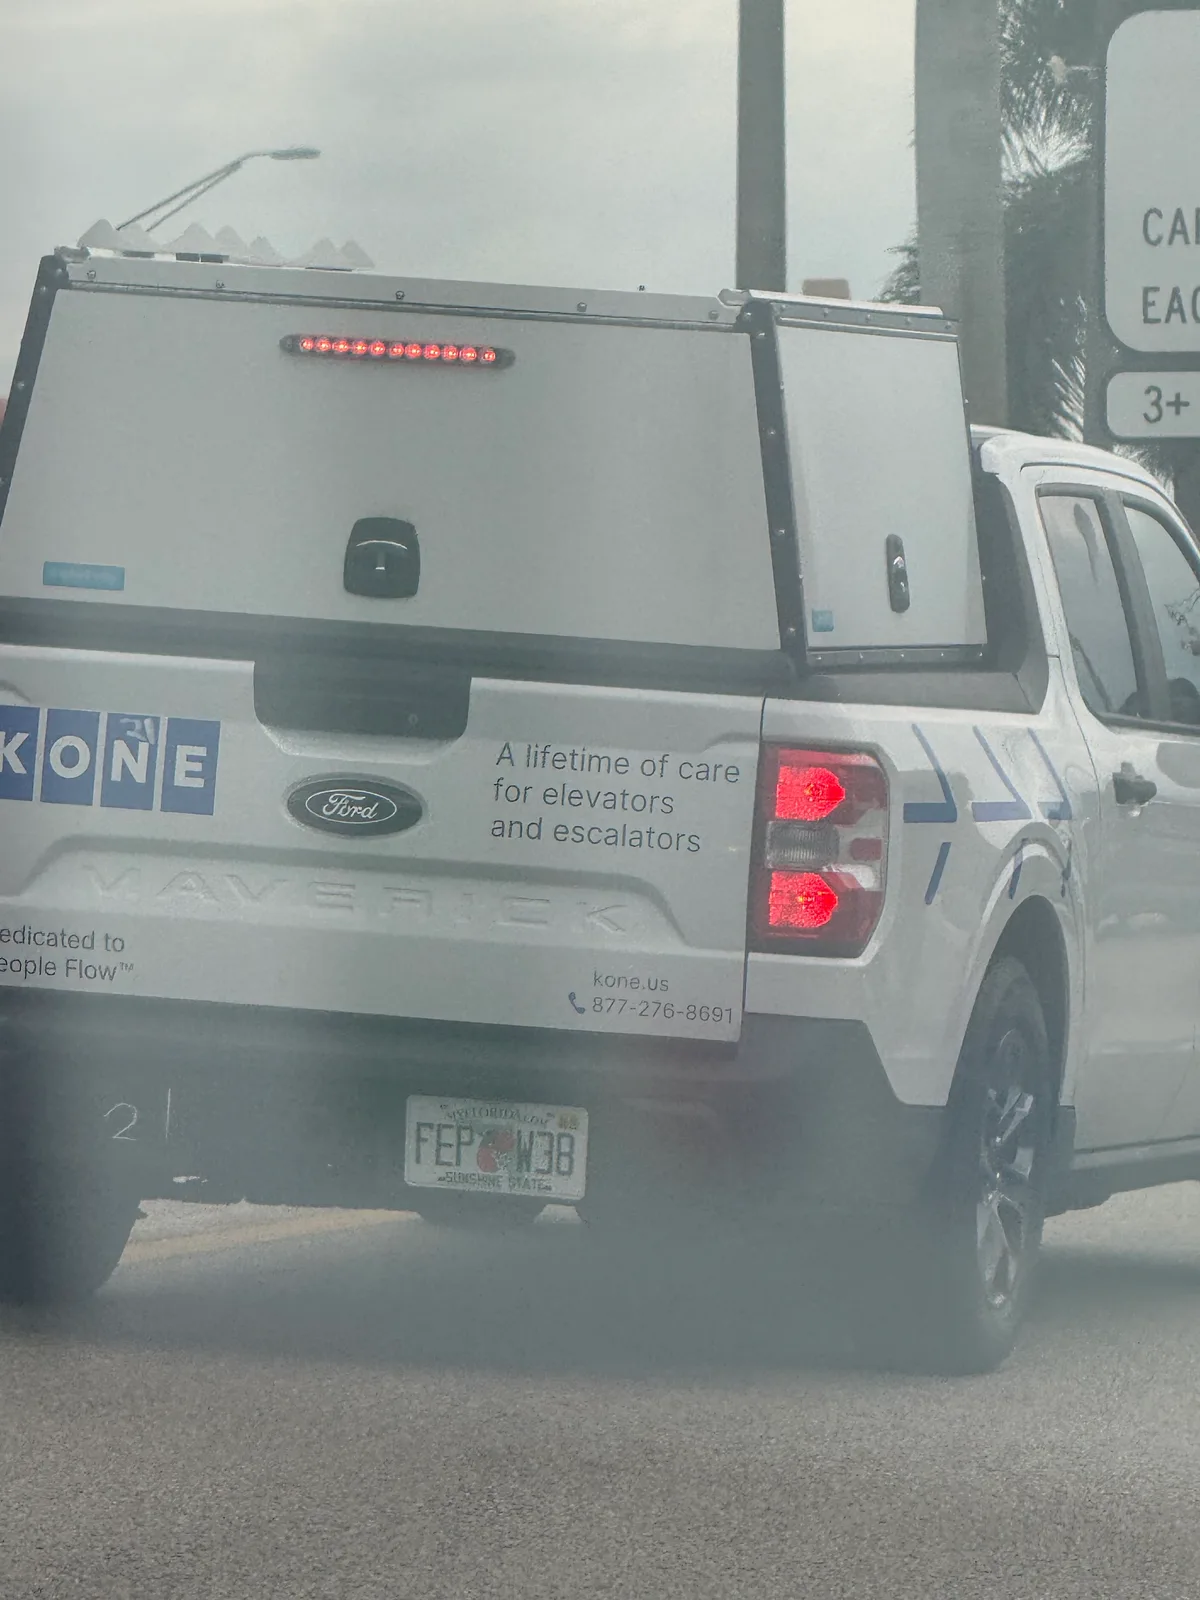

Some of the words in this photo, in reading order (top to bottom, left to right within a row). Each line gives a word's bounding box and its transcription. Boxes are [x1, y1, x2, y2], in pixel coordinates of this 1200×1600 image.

[1142, 206, 1200, 247] CA
[1142, 385, 1191, 424] 3+
[0, 731, 207, 788] KONE
[496, 741, 515, 767] A
[526, 743, 630, 775] lifetime
[640, 753, 669, 778] of
[678, 761, 740, 784] care
[322, 793, 379, 819] Ford
[493, 776, 533, 804] for
[542, 783, 674, 815] elevators
[491, 817, 543, 841] and
[553, 823, 701, 853] escalators
[104, 932, 125, 952] to
[593, 970, 669, 992] kone.us
[592, 996, 733, 1024] 877-276-8691
[415, 1121, 475, 1167] FEP
